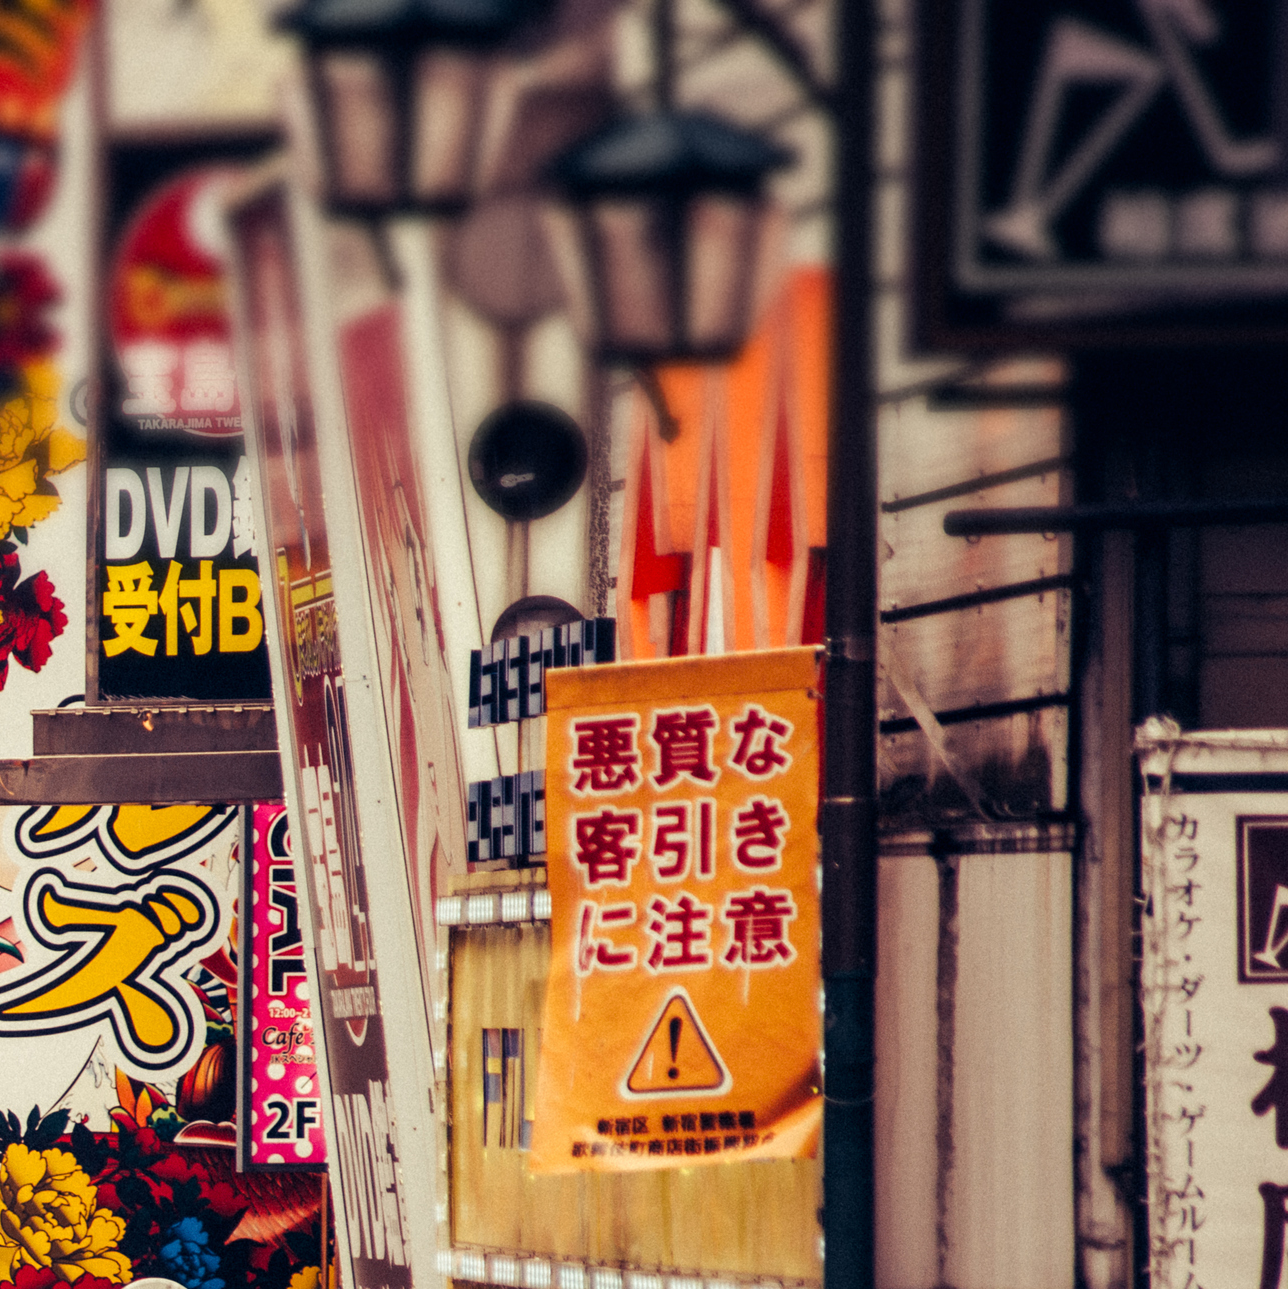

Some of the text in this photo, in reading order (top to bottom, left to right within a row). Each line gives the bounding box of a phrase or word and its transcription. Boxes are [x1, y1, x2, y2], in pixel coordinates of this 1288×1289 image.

[137, 417, 213, 430] TAKARAJIMA
[572, 705, 792, 794] 悪質な
[572, 799, 792, 885] 客引き
[575, 890, 794, 974] に注意
[262, 1026, 304, 1055] Cafe
[264, 1098, 320, 1142] 2F
